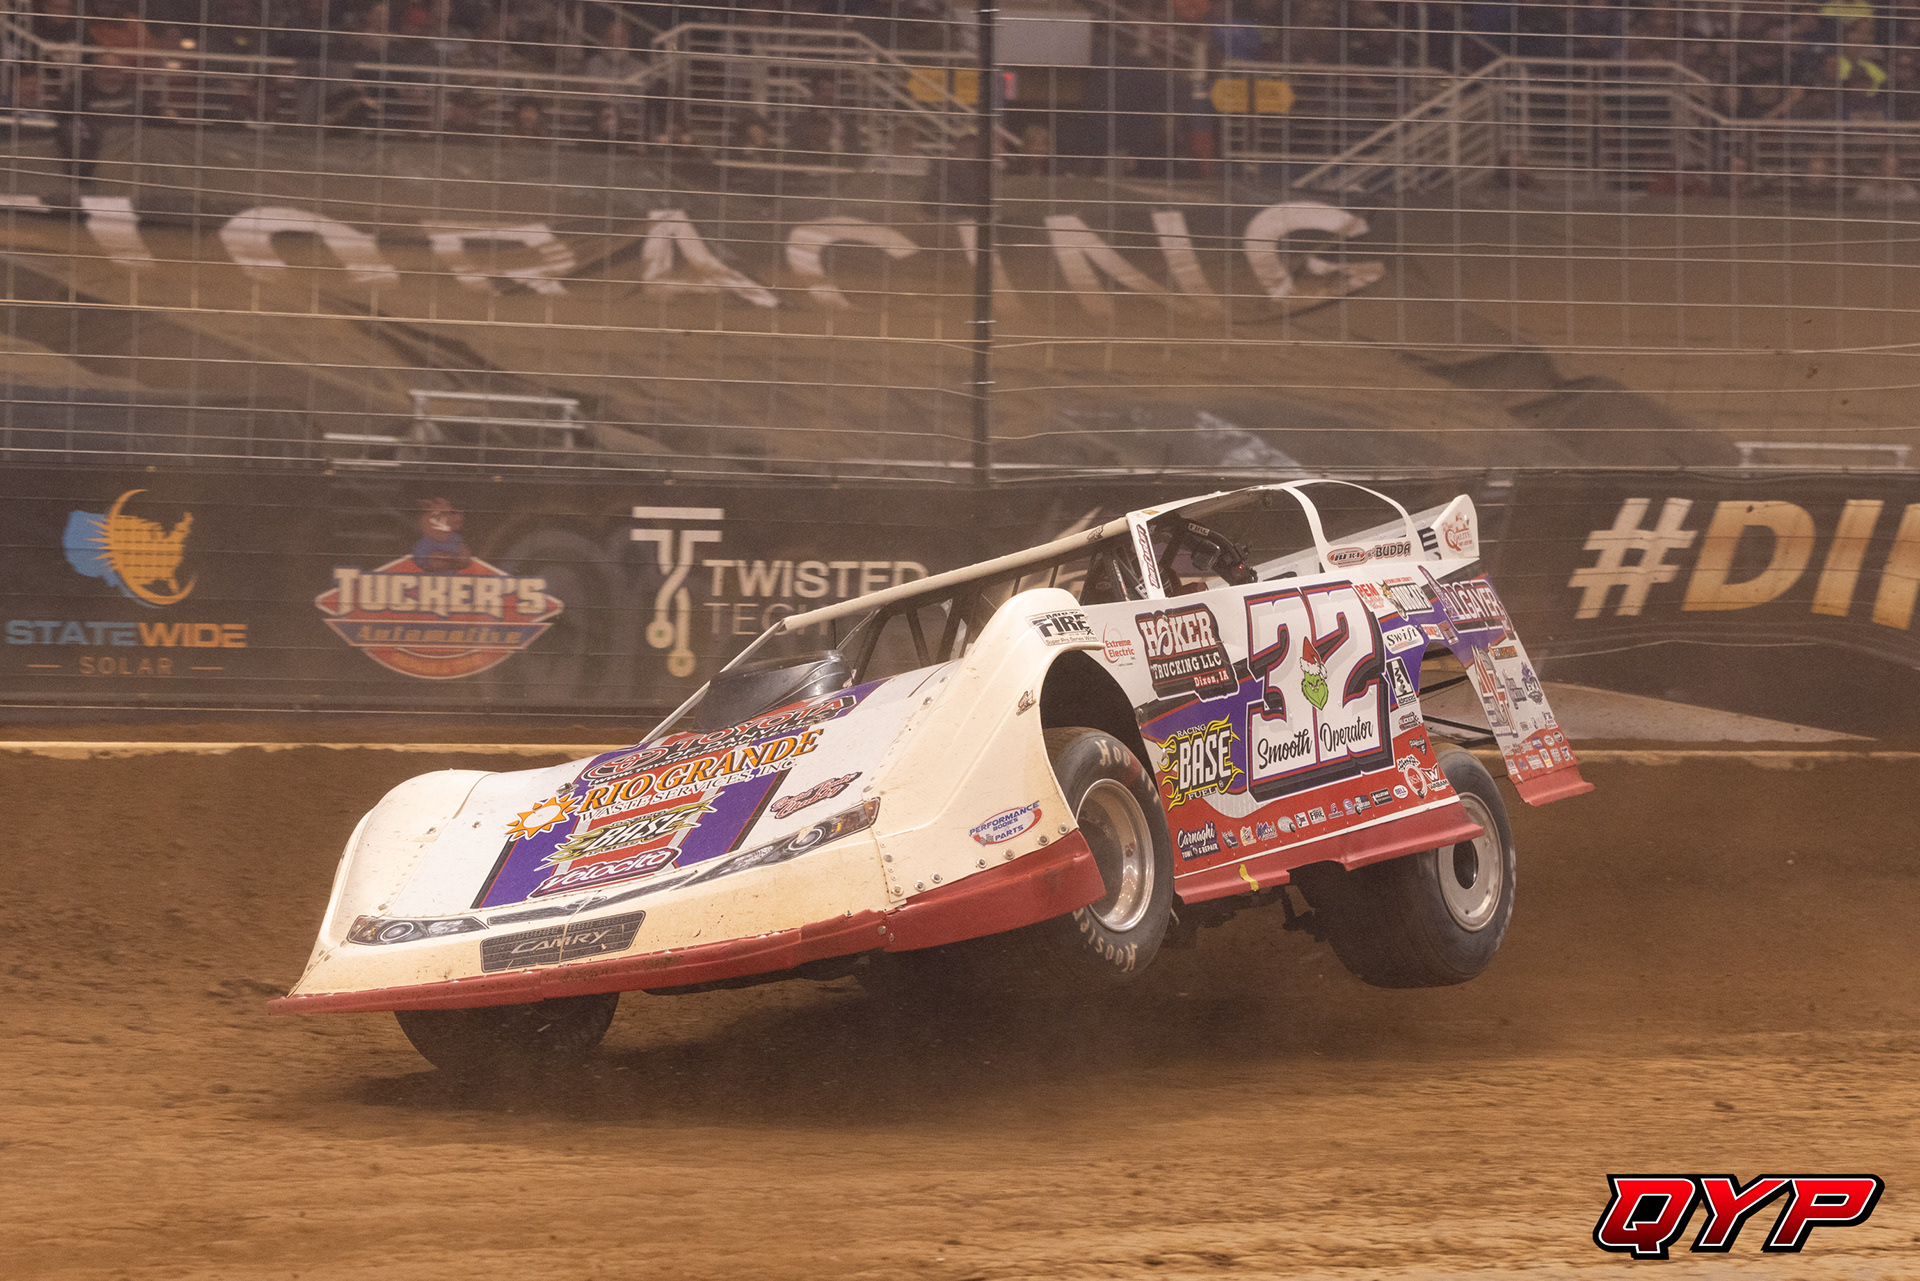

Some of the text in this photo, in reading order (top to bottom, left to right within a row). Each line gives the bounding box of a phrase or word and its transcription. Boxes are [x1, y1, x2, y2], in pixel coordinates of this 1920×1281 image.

[1375, 543, 1411, 558] BUDDA
[703, 560, 929, 598] TWISTED
[1354, 583, 1380, 598] PEM
[334, 567, 547, 619] TUCKER'S
[703, 603, 831, 637] TECH
[6, 620, 248, 648] STATEWIDE
[1105, 639, 1131, 649] Extreme
[1139, 611, 1217, 657] HOKER
[1386, 627, 1418, 646] Swift
[79, 656, 174, 676] SOLAR
[1108, 648, 1135, 659] Electric
[1151, 656, 1199, 680] TRUCKING
[1200, 651, 1222, 669] LLC
[1219, 670, 1229, 682] IA
[1247, 586, 1385, 785] 32
[682, 698, 843, 749] TOYOTA
[1177, 724, 1207, 738] RACING
[591, 721, 813, 786] WWW.TOYOTAOFDANVILLE.CO
[668, 745, 708, 762] OF
[1257, 729, 1313, 770] Smooth
[1320, 716, 1374, 753] Operator
[580, 728, 824, 813] RIO GRANDE
[1180, 730, 1232, 790] BASE
[1188, 788, 1218, 800] FUEL
[582, 796, 649, 823] WASTE
[969, 799, 1041, 837] PERFORMANCE
[585, 812, 693, 852] BASE
[993, 818, 1019, 832] BODIES
[995, 825, 1024, 841] PARTS
[1177, 821, 1215, 848] Carnaghi
[511, 929, 610, 954] CAMRY
